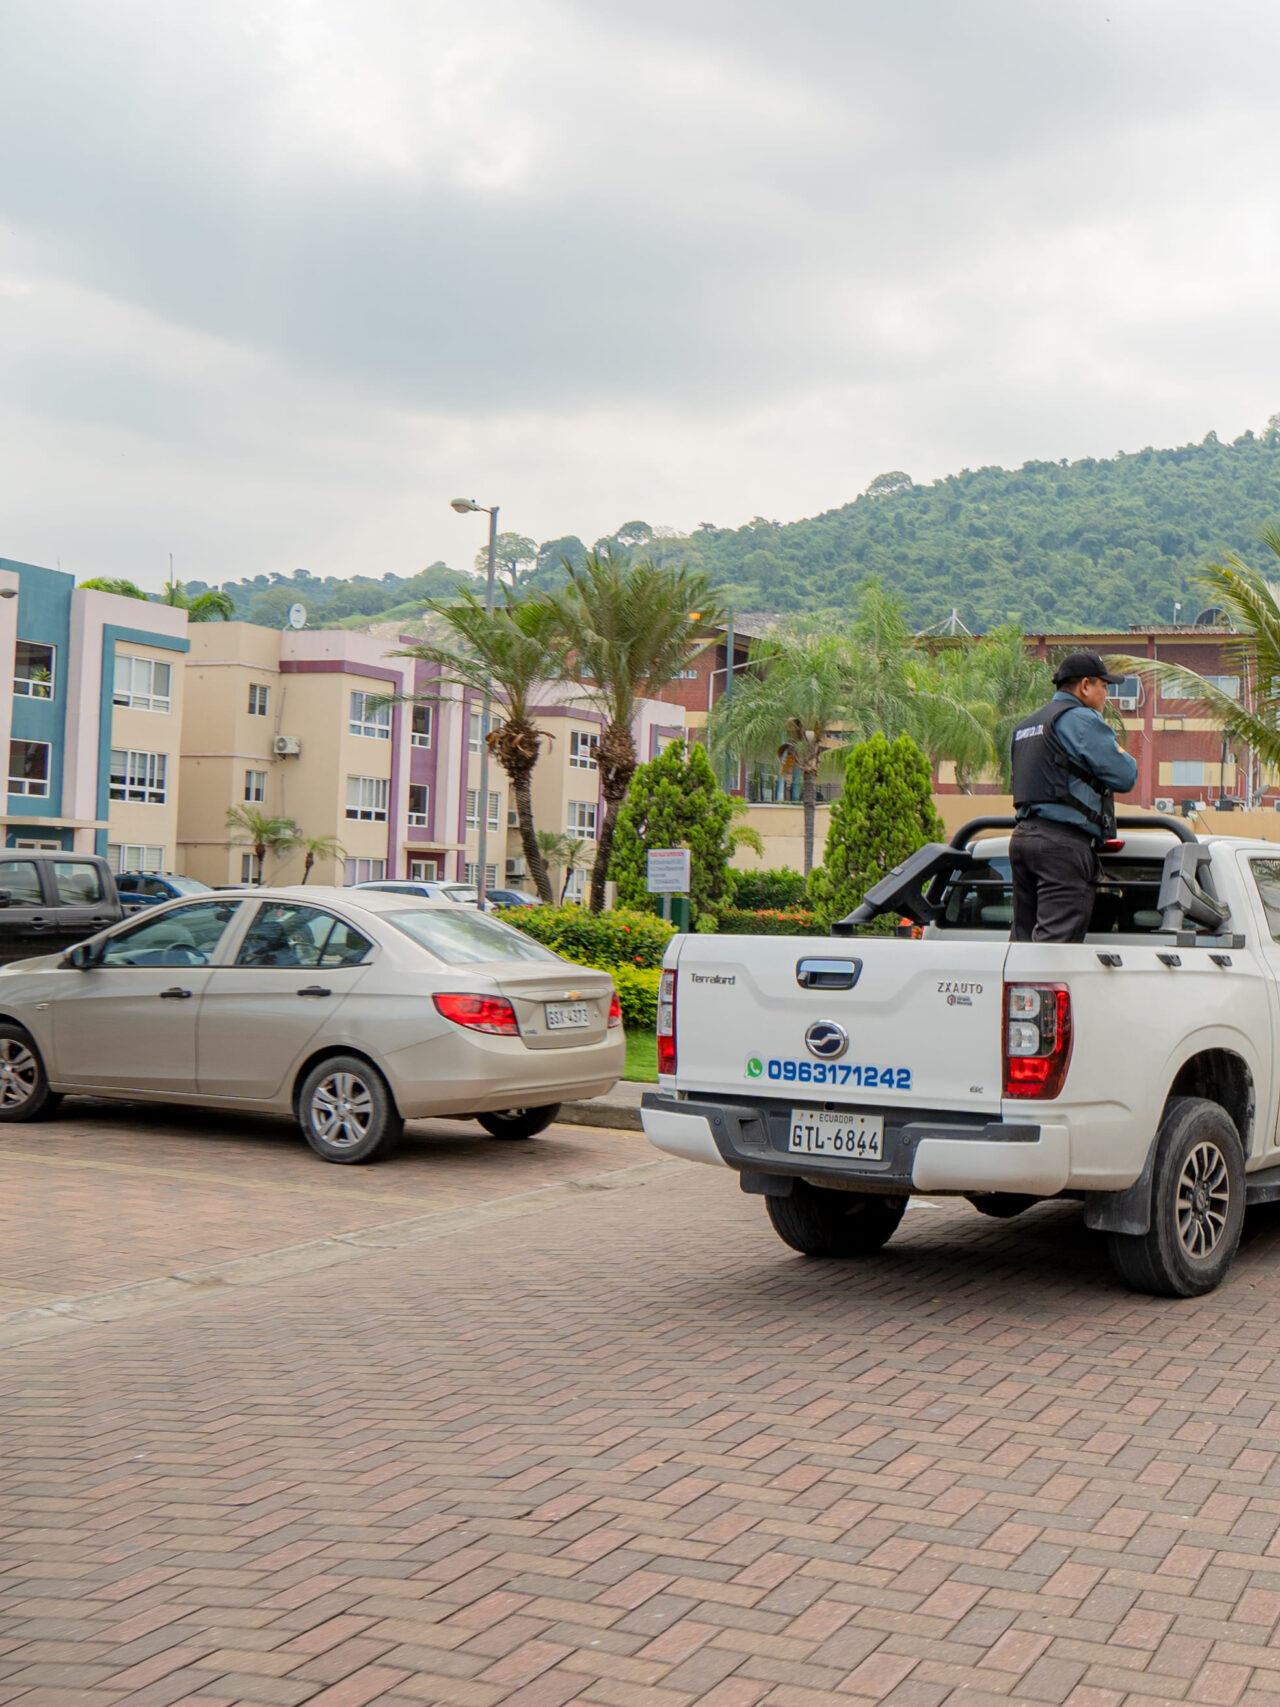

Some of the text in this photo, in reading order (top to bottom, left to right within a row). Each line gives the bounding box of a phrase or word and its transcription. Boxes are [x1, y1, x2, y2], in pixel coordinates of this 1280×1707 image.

[937, 982, 983, 994] ZXAUTO
[768, 1060, 911, 1089] 0963171242
[819, 1113, 853, 1125] ECUADOR
[792, 1125, 878, 1155] GTL-6844
